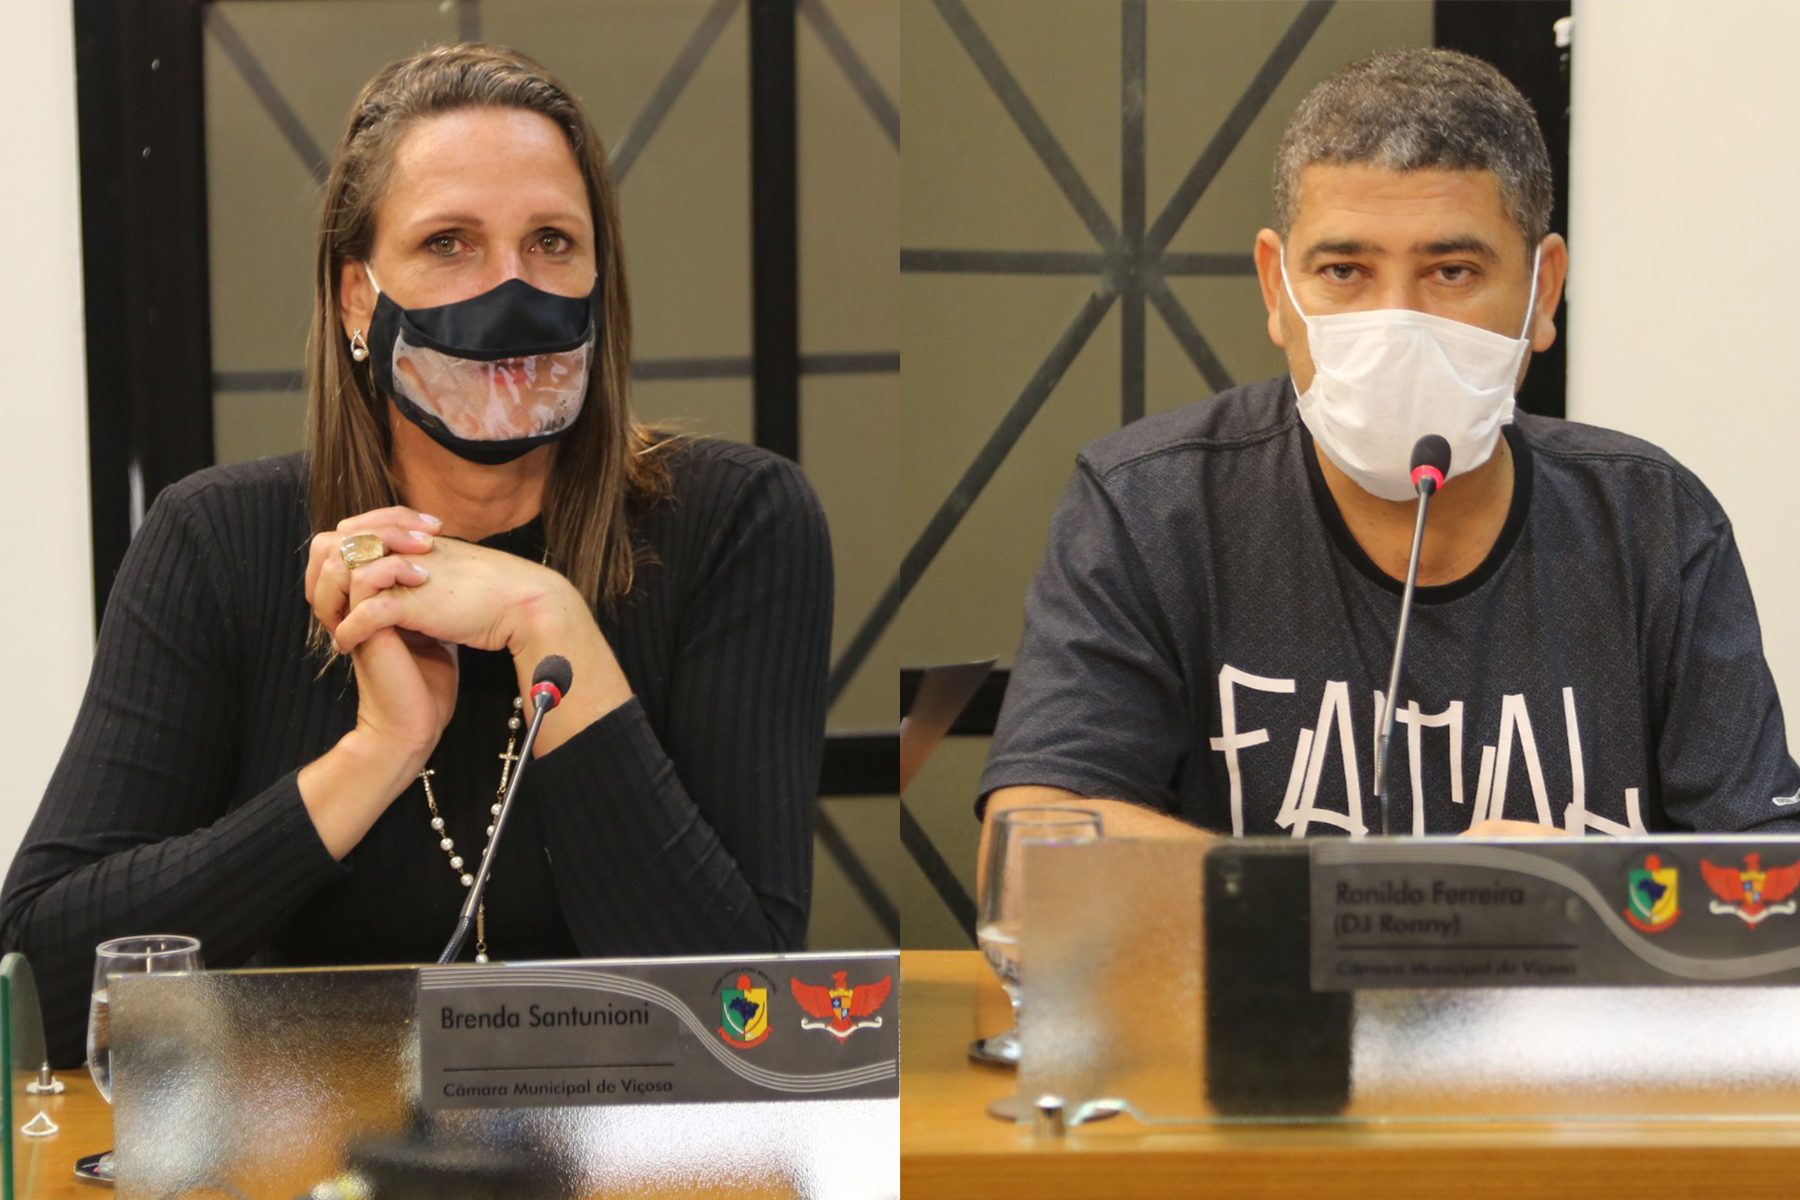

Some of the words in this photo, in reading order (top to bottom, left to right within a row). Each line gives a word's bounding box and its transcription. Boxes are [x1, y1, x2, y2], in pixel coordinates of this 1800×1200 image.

[1336, 880, 1424, 905] Ronildo
[1432, 880, 1526, 905] Ferreira
[1334, 913, 1372, 937] (DJ
[1380, 913, 1461, 937] Ronny)
[441, 1005, 520, 1029] Brenda
[528, 1002, 649, 1027] Santunioni
[443, 1081, 508, 1097] Câmara
[513, 1079, 591, 1097] Municipal
[596, 1080, 616, 1093] de
[620, 1078, 673, 1096] Viçosa
